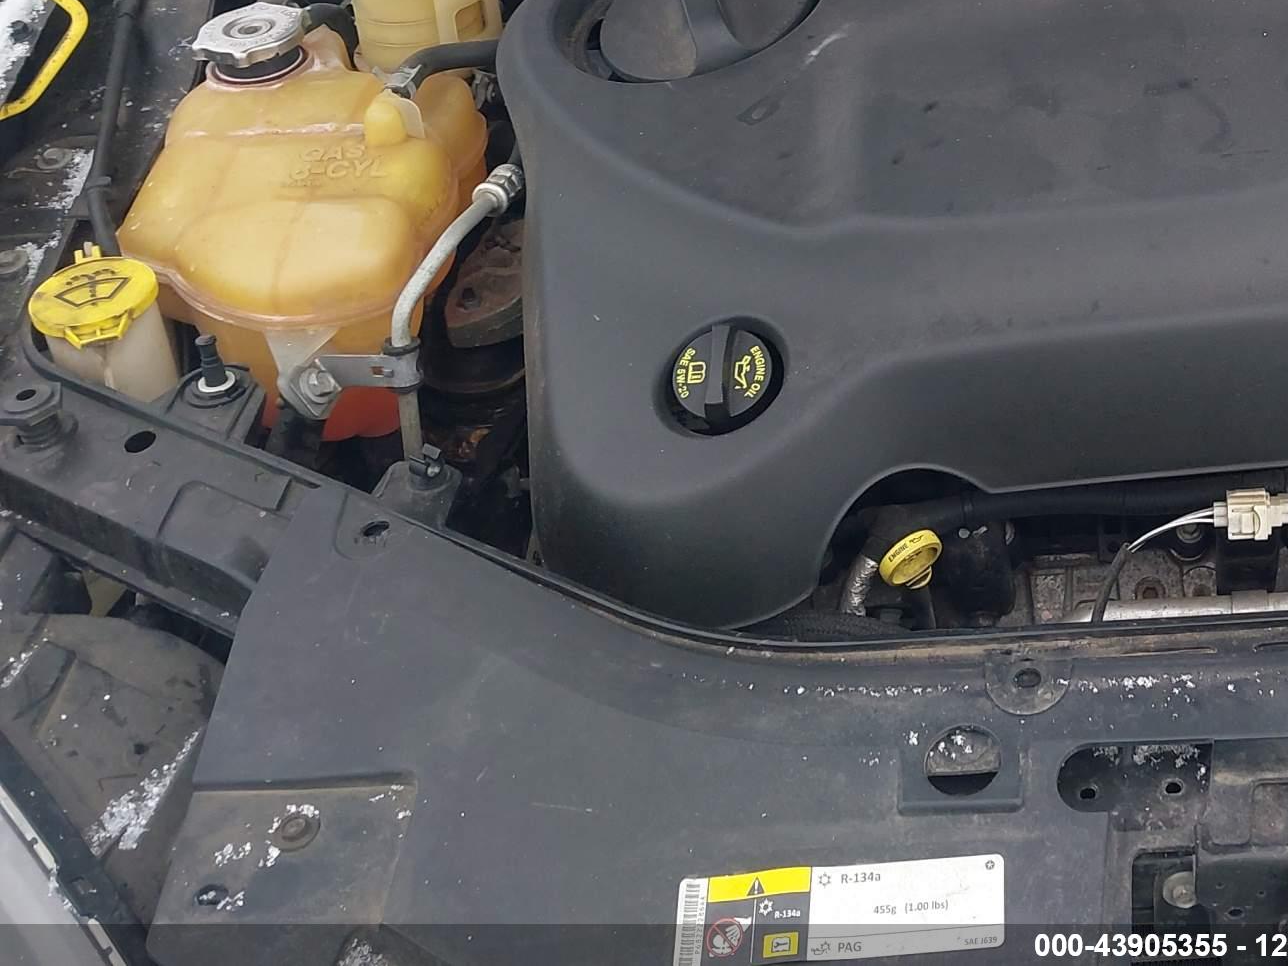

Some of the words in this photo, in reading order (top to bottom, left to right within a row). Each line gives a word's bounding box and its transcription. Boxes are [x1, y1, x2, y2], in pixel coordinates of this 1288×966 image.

[680, 348, 695, 367] SAE
[750, 346, 766, 382] ENGINE
[743, 382, 761, 398] OIL
[841, 872, 881, 884] R-134a
[774, 909, 801, 919] R-134a
[873, 904, 897, 916] 455g
[904, 902, 929, 914] (1.00
[931, 899, 949, 911] lbs)
[837, 941, 862, 953] PAG
[963, 937, 979, 946] SAE
